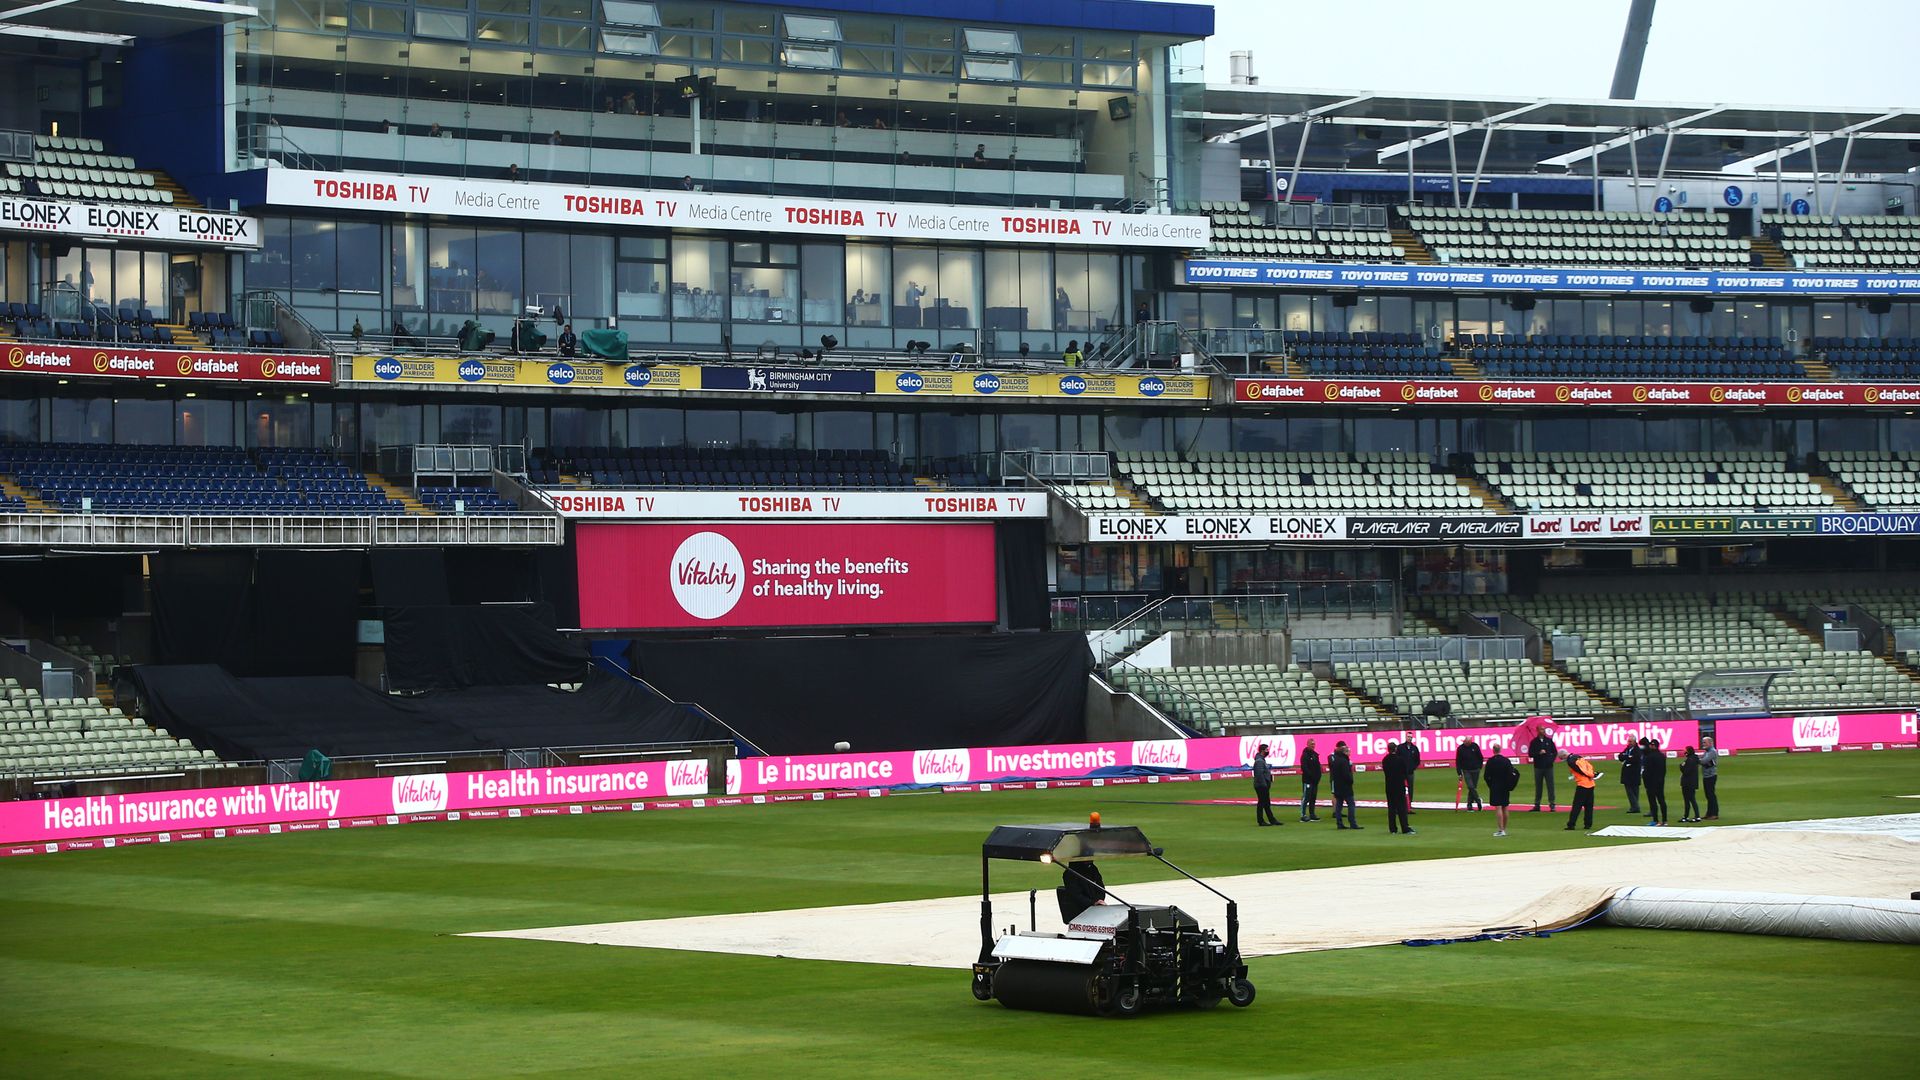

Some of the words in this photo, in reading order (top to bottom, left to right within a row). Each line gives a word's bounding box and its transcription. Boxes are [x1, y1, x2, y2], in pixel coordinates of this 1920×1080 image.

[314, 180, 397, 201] TOSHIBA
[408, 186, 430, 203] TV
[455, 190, 493, 208] Media
[498, 193, 540, 210] Centre
[564, 195, 644, 216] TOSHIBA
[656, 201, 677, 217] TV
[689, 204, 728, 220] Media
[731, 206, 772, 222] Centre
[785, 207, 864, 226] TOSHIBA
[877, 212, 897, 228] TV
[908, 214, 946, 230] Media
[949, 216, 990, 232] Centre
[1002, 217, 1080, 235] TOSHIBA
[1093, 220, 1112, 235] TV
[1122, 223, 1159, 237] Media
[1162, 224, 1202, 238] Centre
[2, 202, 72, 224] ELONEX
[88, 208, 160, 231] ELONEX
[179, 215, 248, 237] ELONEX
[1190, 267, 1222, 277] TOYO
[1224, 268, 1258, 278] TIRES
[1266, 269, 1298, 278] TOYO
[1299, 270, 1333, 280] TIRES
[1341, 271, 1373, 280] TOYO
[1374, 271, 1408, 281] TIRES
[1416, 272, 1449, 282] TOYO
[1450, 273, 1483, 282] TIRES
[1492, 274, 1524, 283] TOYO
[1525, 274, 1558, 284] TIRES
[1566, 275, 1598, 284] TOYO
[1600, 276, 1634, 286] TIRES
[1642, 276, 1674, 286] TOYO
[1676, 277, 1708, 287] TIRES
[1716, 277, 1749, 287] TOYO
[1750, 278, 1784, 287] TIRES
[1792, 278, 1824, 288] TOYO
[1825, 278, 1858, 288] TIRES
[1866, 279, 1897, 288] TOYO
[26, 352, 71, 367] dafabet
[110, 355, 154, 371] dafabet
[193, 357, 238, 374] dafabet
[276, 359, 320, 376] dafabet
[376, 363, 401, 373] selco
[460, 365, 484, 375] selco
[549, 368, 573, 378] selco
[626, 370, 650, 380] selco
[770, 372, 814, 380] BIRMINGHAM
[816, 373, 832, 381] CITY
[898, 377, 922, 386] selco
[975, 378, 999, 388] selco
[770, 381, 800, 390] University
[1061, 380, 1085, 389] selco
[1140, 381, 1164, 390] selco
[1261, 386, 1304, 398] dafabet
[1339, 386, 1380, 398] dafabet
[1416, 387, 1458, 399] dafabet
[1493, 388, 1535, 399] dafabet
[1570, 388, 1612, 400] dafabet
[1648, 389, 1690, 400] dafabet
[1725, 389, 1766, 401] dafabet
[1802, 389, 1843, 401] dafabet
[1879, 389, 1920, 401] dafabet
[636, 497, 655, 512] TV
[739, 497, 812, 512] TOSHIBA
[822, 497, 841, 512] TV
[925, 497, 998, 512] TOSHIBA
[1008, 498, 1026, 512] TV
[1100, 518, 1167, 535] ELONEX
[1185, 518, 1252, 534] ELONEX
[1270, 517, 1336, 533] ELONEX
[1352, 522, 1430, 533] PLAYERLAYER
[1439, 522, 1519, 533] PLAYERLAYER
[1654, 520, 1730, 529] ALLETT
[1740, 520, 1813, 529] ALLETT
[1822, 516, 1918, 534] BROADWAY
[678, 557, 737, 593] Vitality
[752, 558, 812, 578] Sharing
[814, 558, 841, 574] the
[844, 558, 909, 574] benefits
[752, 578, 771, 596] of
[774, 578, 834, 600] healthy
[837, 578, 884, 600] living.
[1552, 724, 1592, 747] with
[986, 746, 1116, 772] Investments
[1137, 741, 1181, 769] Vitality
[785, 757, 893, 781] insurance
[919, 749, 963, 780] Vitality
[398, 776, 444, 808] Vitality
[468, 770, 540, 800] Health
[546, 769, 648, 795] insurance
[44, 796, 113, 829] Health
[119, 794, 216, 822] insurance
[222, 785, 266, 817] with
[270, 783, 340, 816] Vitality
